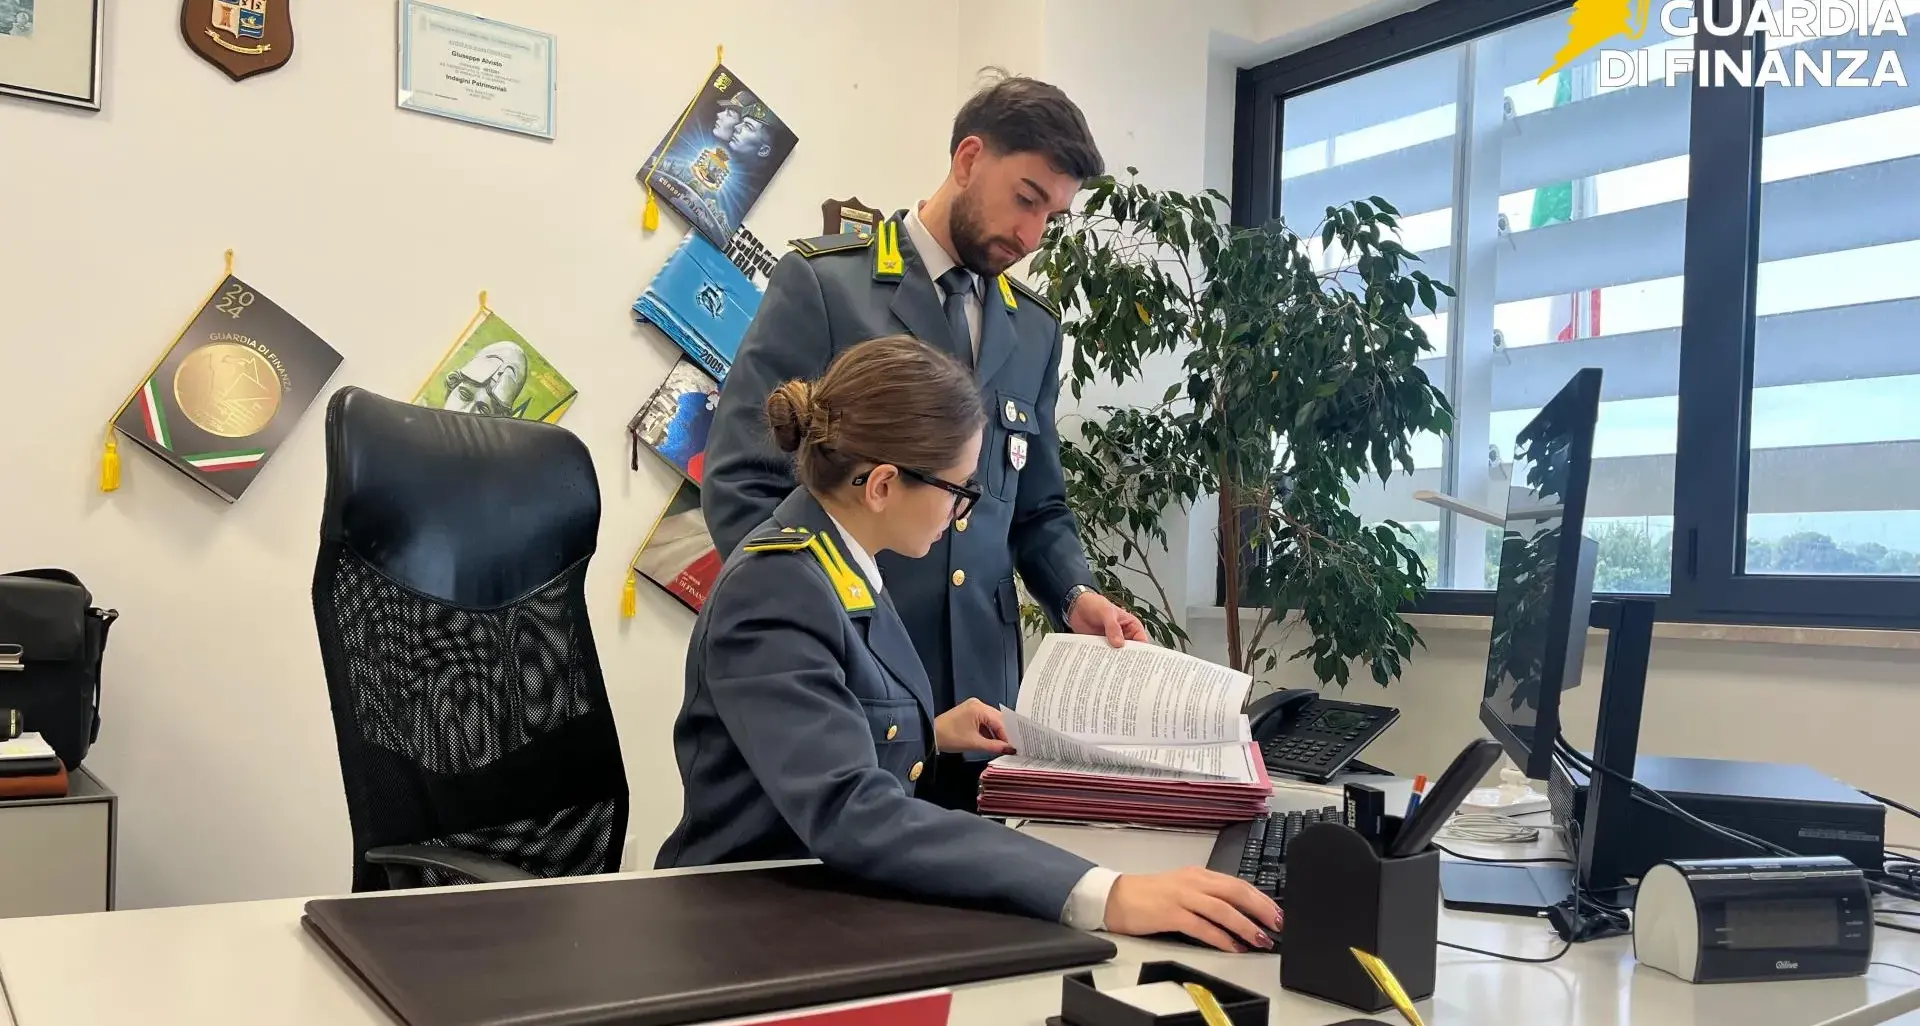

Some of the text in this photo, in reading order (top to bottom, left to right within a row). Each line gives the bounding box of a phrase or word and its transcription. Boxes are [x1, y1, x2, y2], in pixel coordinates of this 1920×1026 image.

[451, 50, 481, 62] Giuseppe
[445, 74, 508, 92] Indagini Patrimoniali
[226, 283, 255, 307] 20
[215, 296, 245, 320] 24
[209, 332, 293, 393] GUARDIA DI FINANZA
[700, 349, 724, 373] 2009
